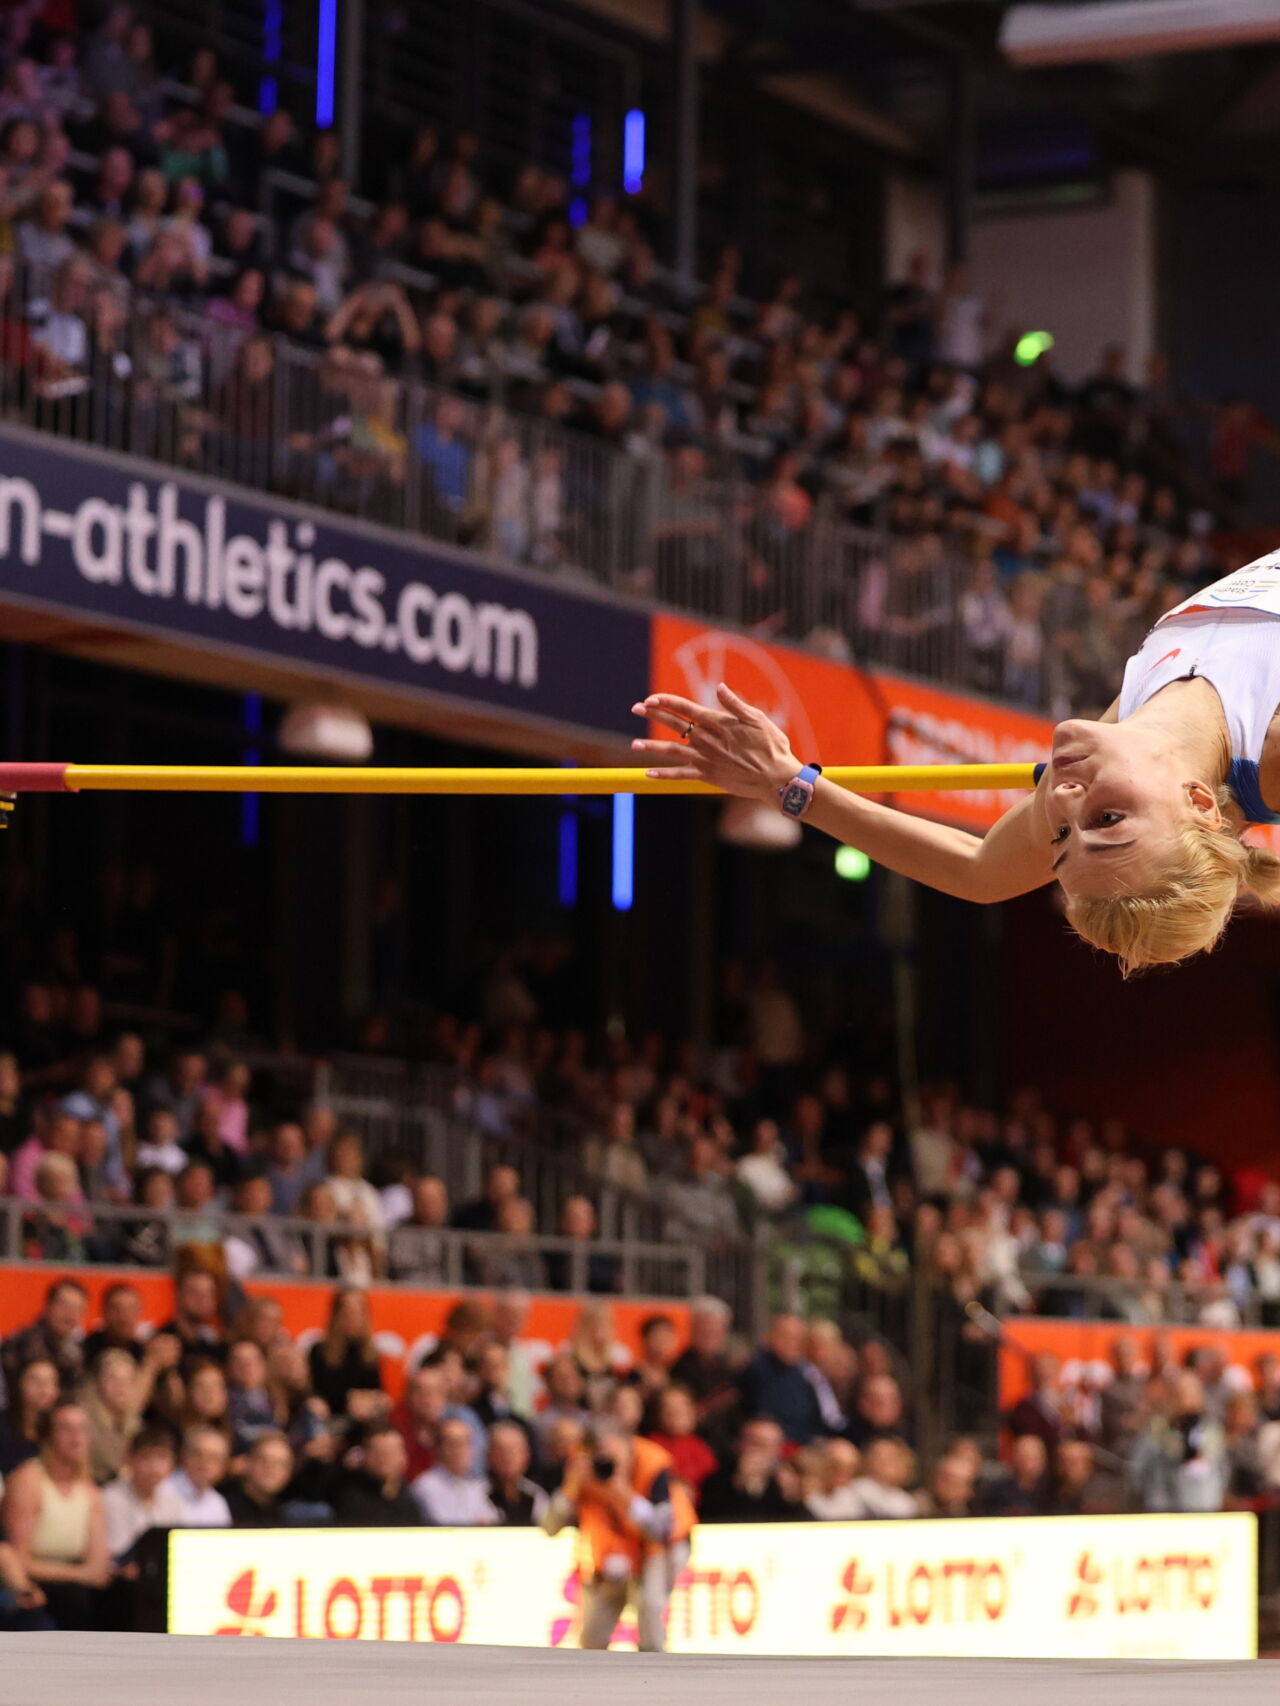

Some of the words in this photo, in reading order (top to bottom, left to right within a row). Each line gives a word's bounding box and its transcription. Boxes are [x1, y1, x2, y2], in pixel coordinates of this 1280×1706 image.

[295, 1576, 464, 1643] LOTTO
[661, 1568, 760, 1637] TTO
[885, 1558, 1006, 1627] LOTTO
[1112, 1552, 1214, 1615] LOTTO
